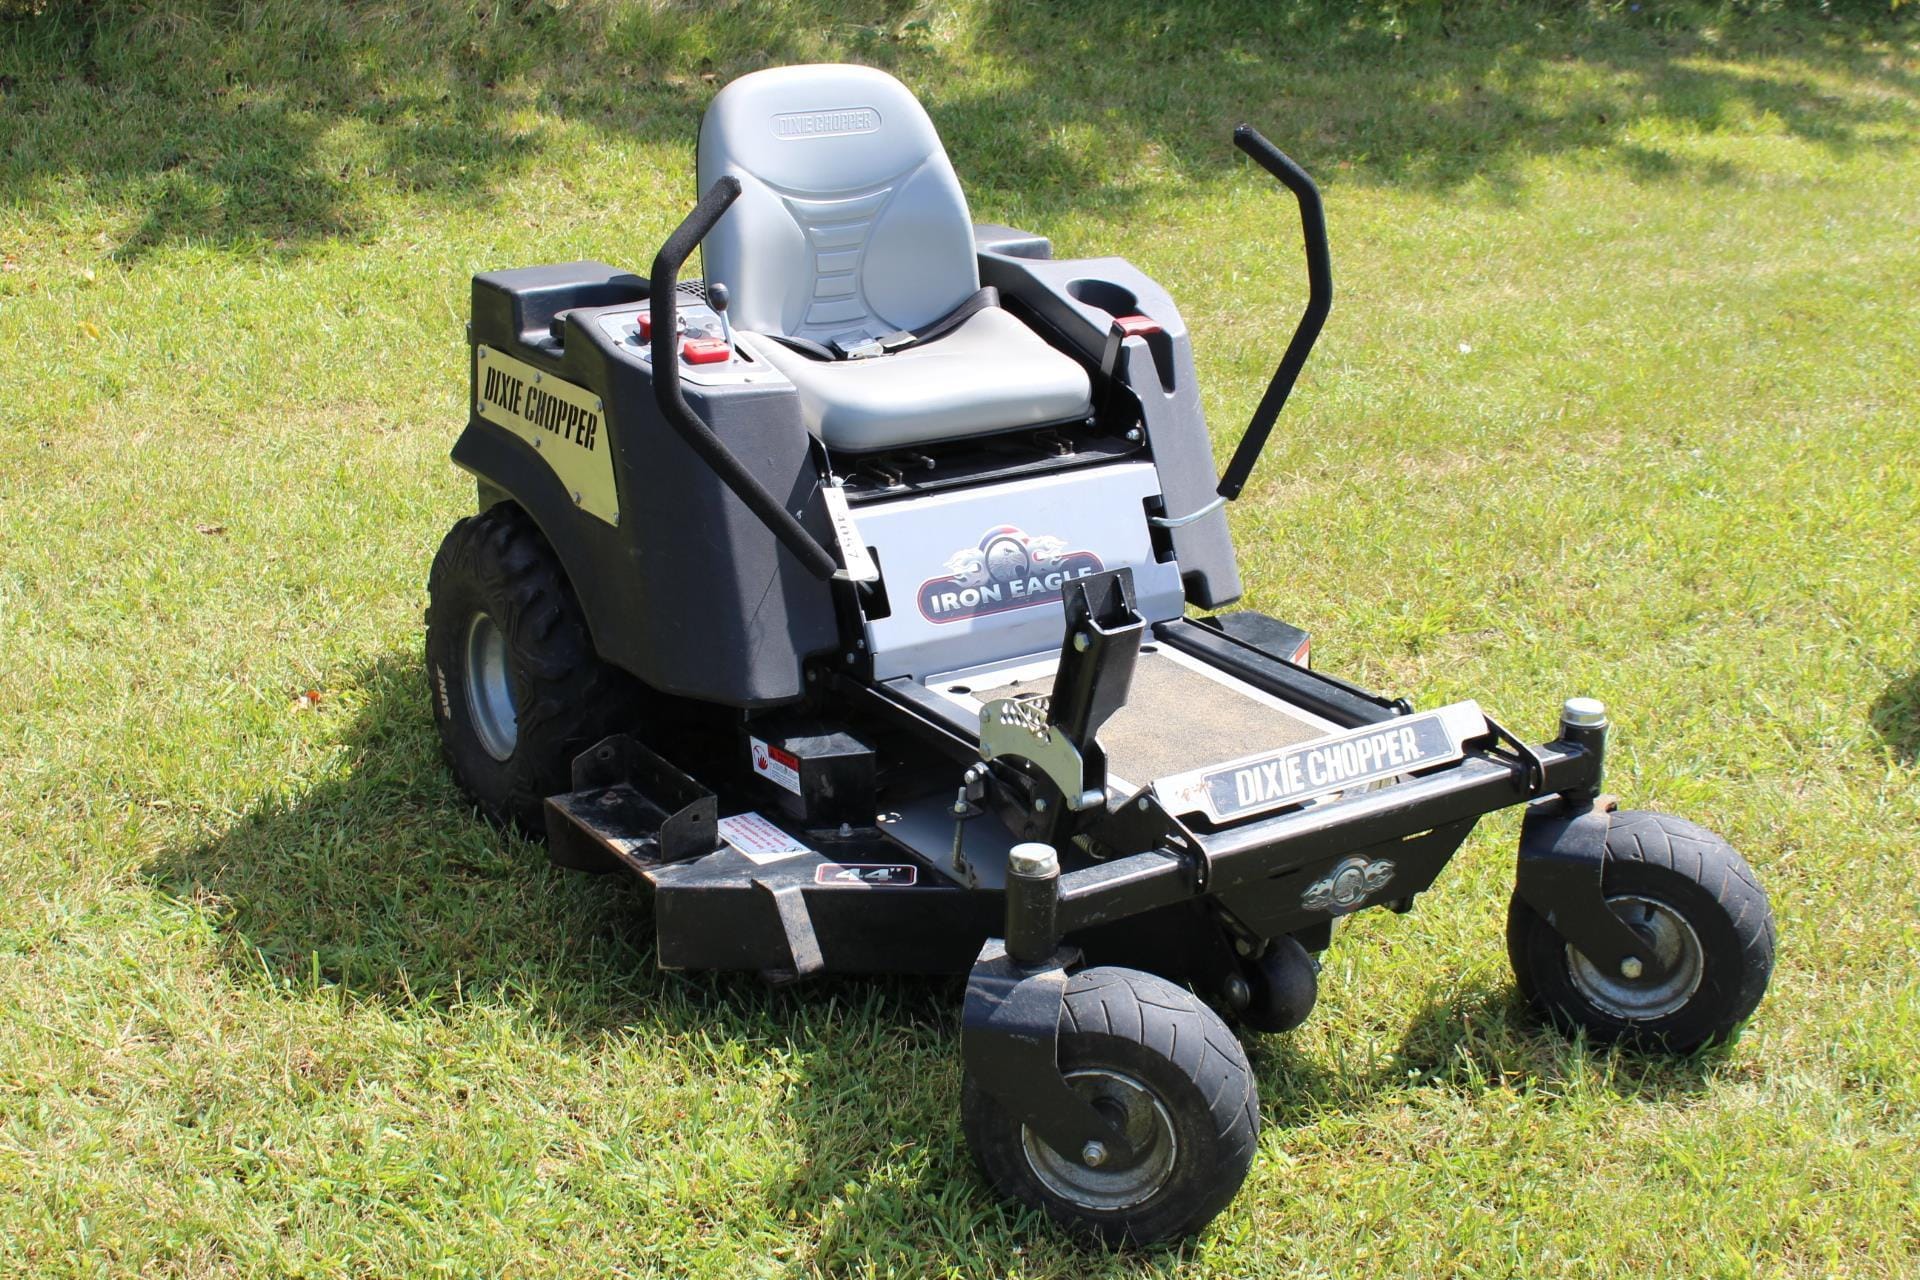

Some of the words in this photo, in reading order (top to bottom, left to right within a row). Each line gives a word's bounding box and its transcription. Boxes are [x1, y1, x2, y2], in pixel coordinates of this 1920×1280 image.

[779, 116, 811, 135] DIXIE
[814, 112, 871, 132] CHOPPER
[484, 366, 523, 415] DIXIE
[525, 386, 598, 452] CHOPPER
[931, 583, 1002, 613] IRON
[1235, 757, 1304, 806] DIXIE
[1308, 727, 1419, 784] CHOPPER
